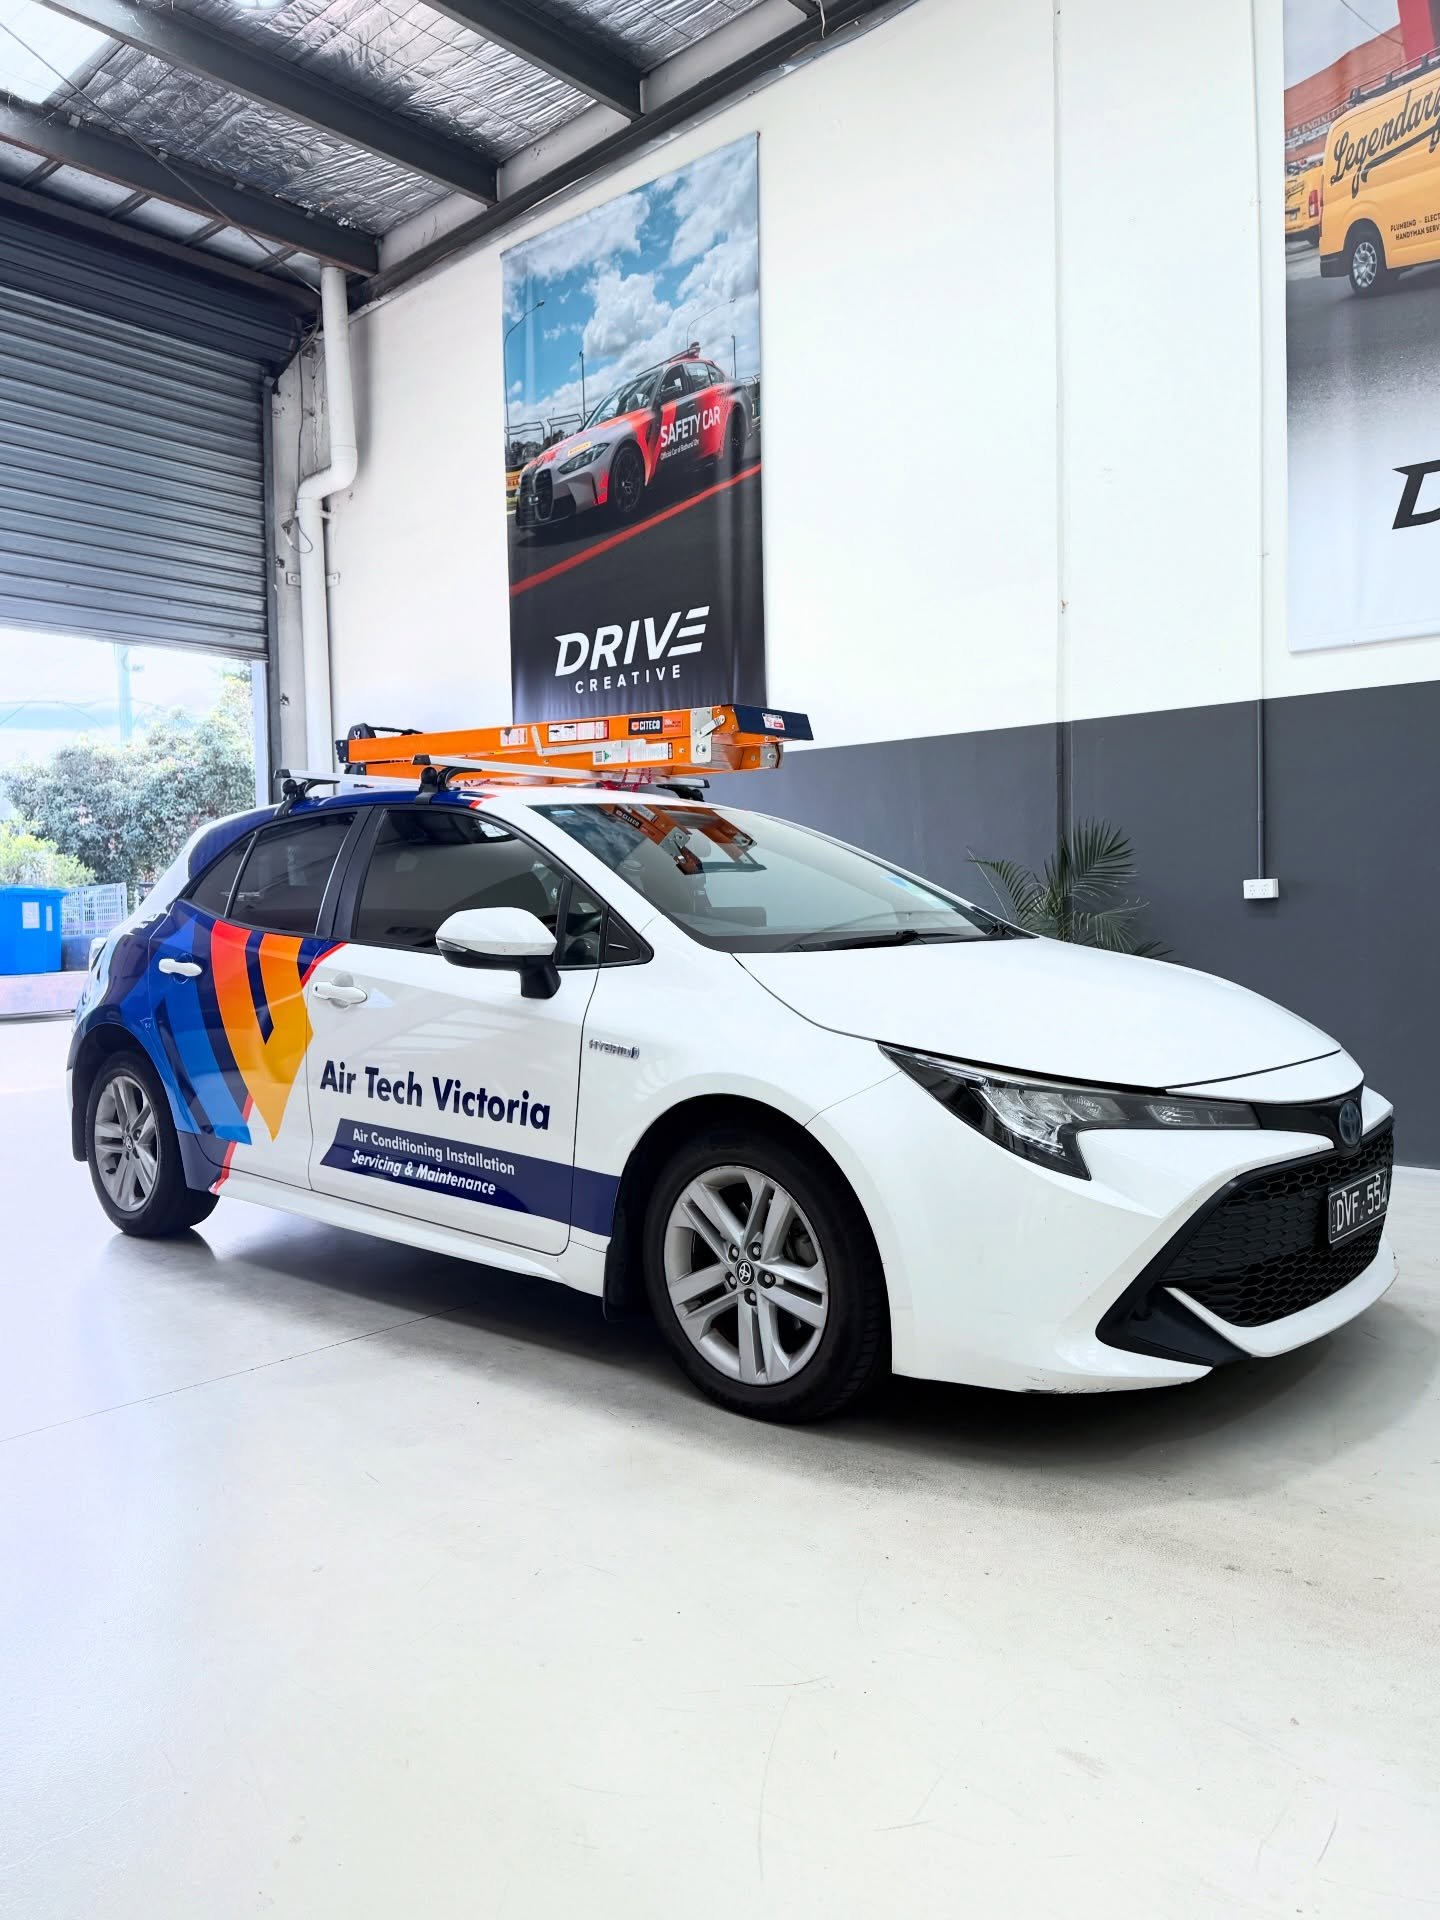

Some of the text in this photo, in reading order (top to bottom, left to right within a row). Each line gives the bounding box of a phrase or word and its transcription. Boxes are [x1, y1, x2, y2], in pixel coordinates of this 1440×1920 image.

[1390, 219, 1417, 231] PLUMBING
[1395, 228, 1425, 240] HANDYMAN
[660, 405, 720, 448] SAFETY CAR
[554, 605, 710, 677] DRIVE
[575, 664, 681, 694] CREATIVE
[639, 719, 660, 731] CITECO
[319, 1060, 551, 1131] Air Tech Victoria
[351, 1149, 497, 1196] Servicing & Maintenance
[352, 1127, 516, 1176] Air Conditioning Installation
[1336, 1190, 1360, 1232] DVF
